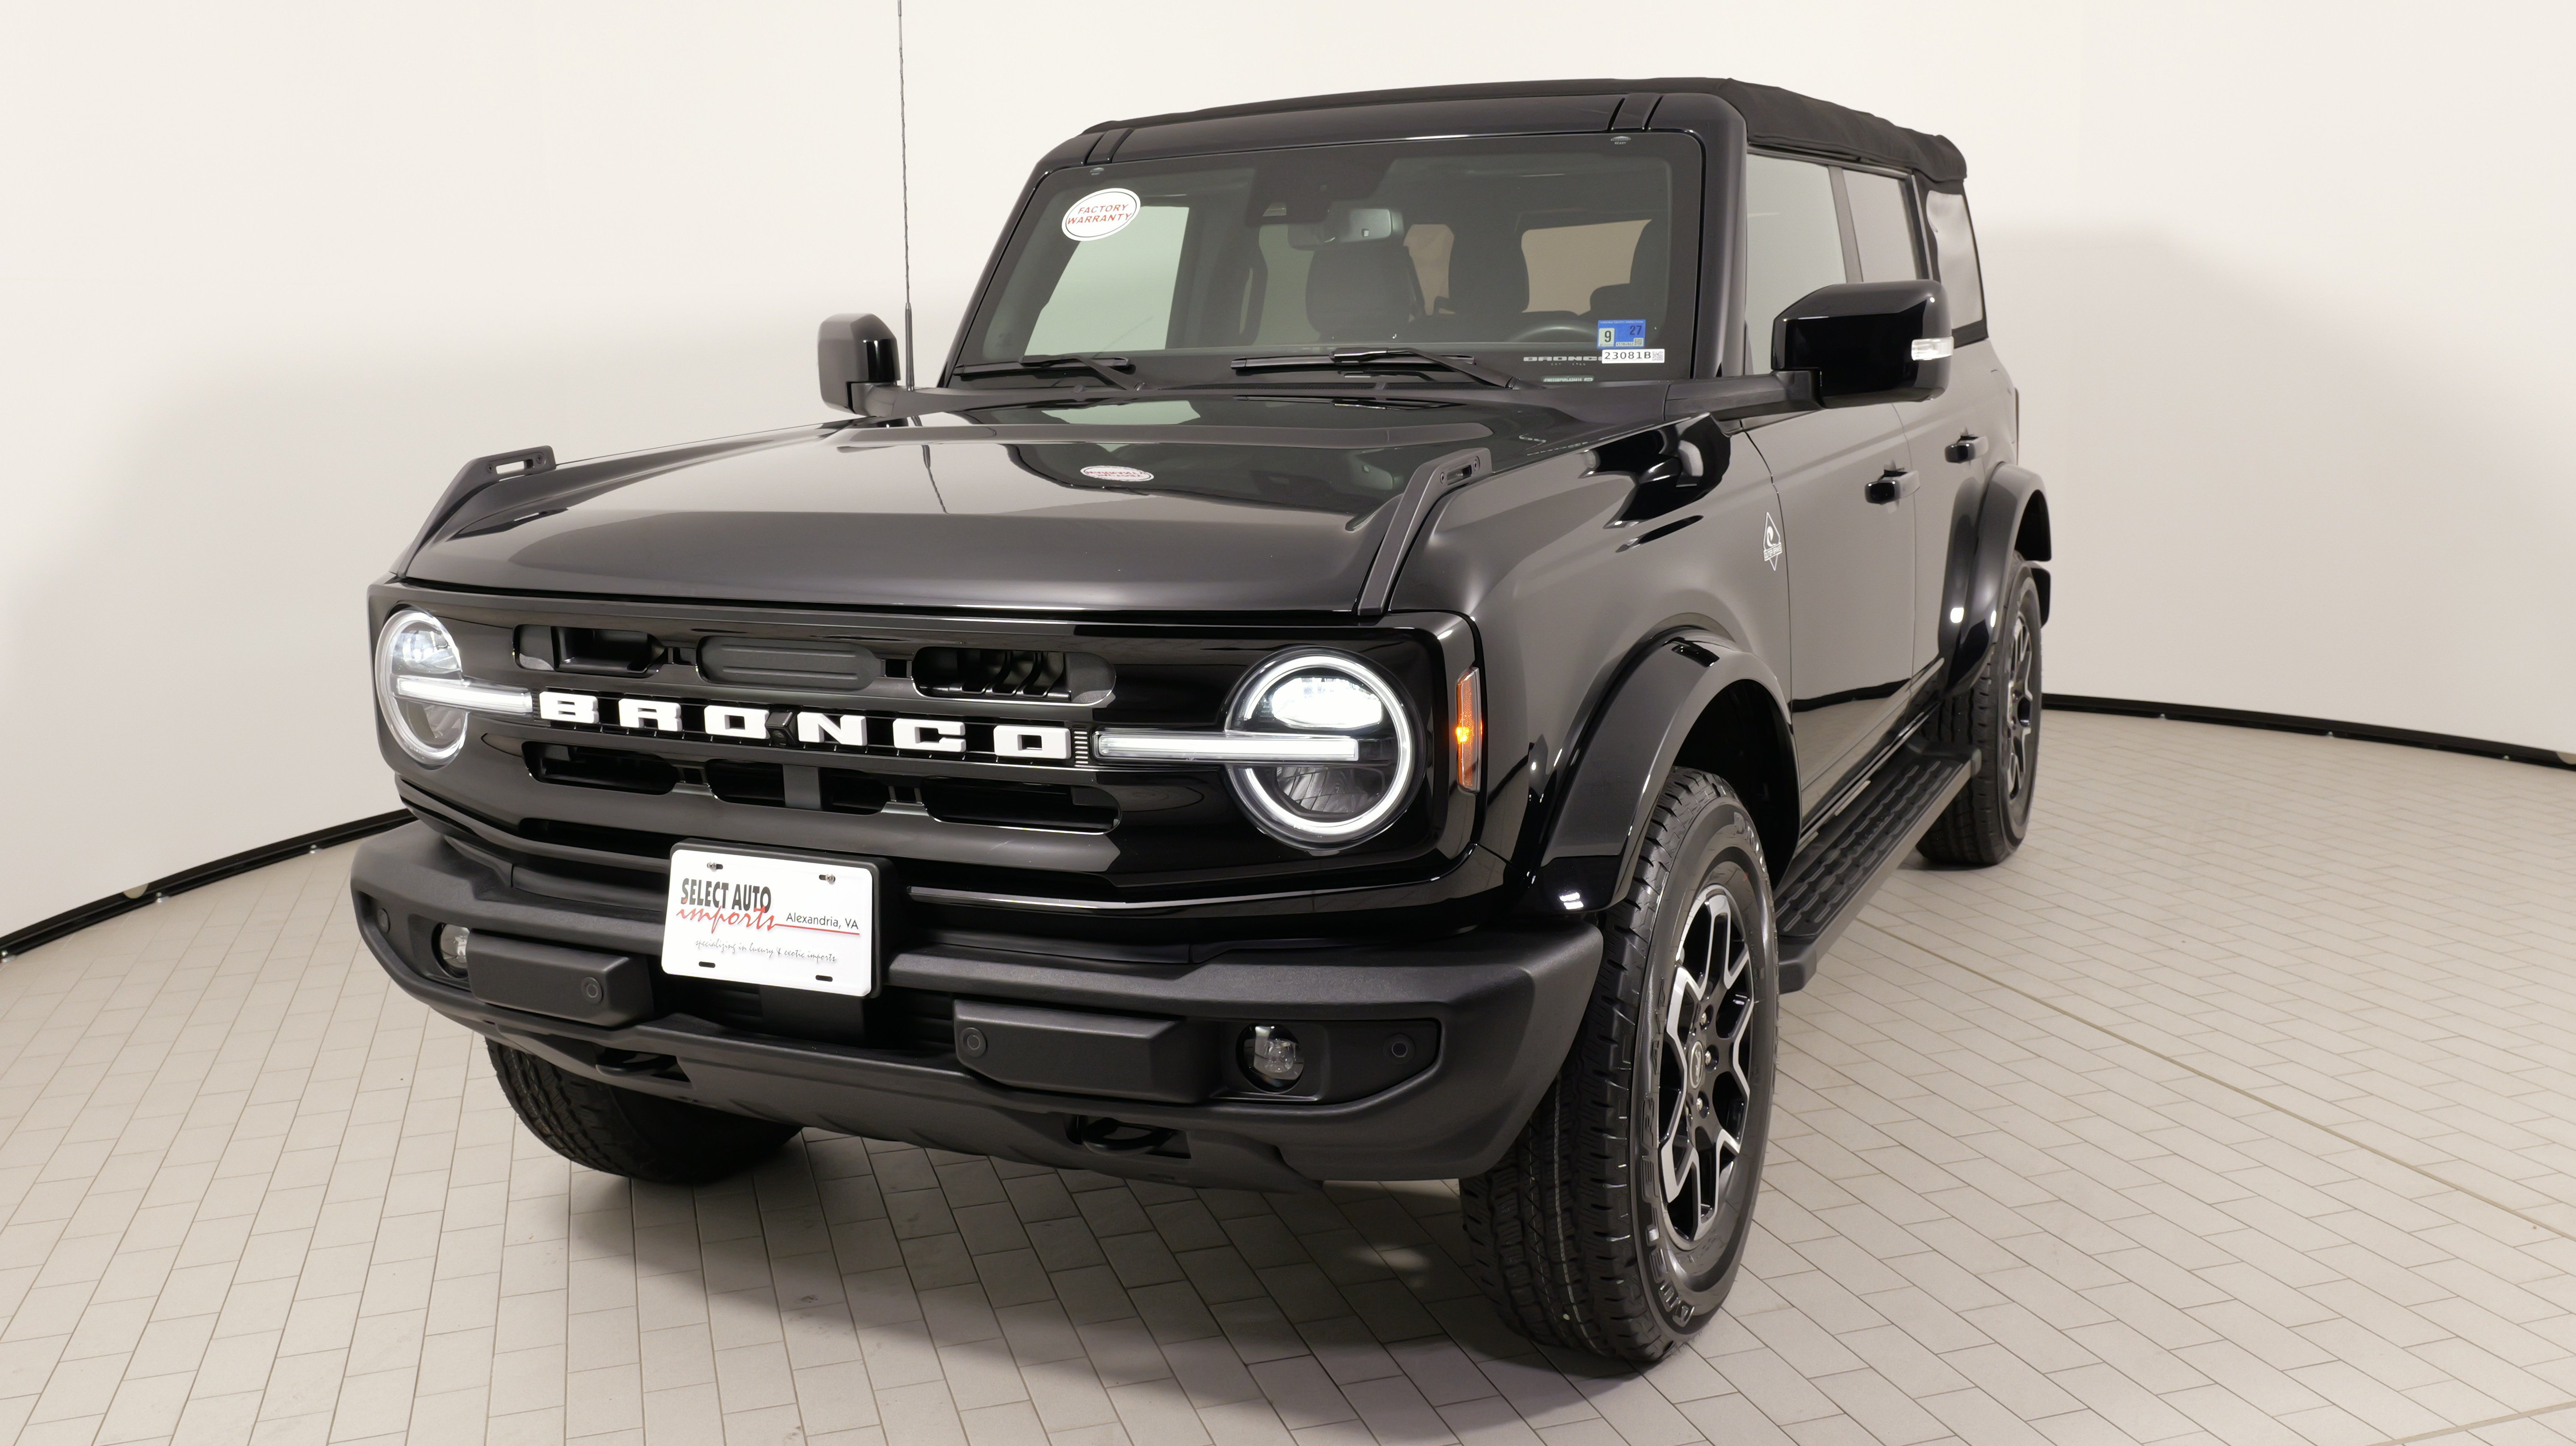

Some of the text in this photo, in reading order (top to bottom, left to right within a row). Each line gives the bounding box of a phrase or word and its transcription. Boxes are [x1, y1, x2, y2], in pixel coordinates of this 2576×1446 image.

[1078, 204, 1129, 214] FACTORY
[1068, 213, 1132, 225] WARRANTY
[1605, 330, 1611, 343] 9
[1629, 325, 1642, 335] 27
[1604, 351, 1651, 360] 23081B
[539, 691, 1072, 759] BRONCO
[680, 878, 771, 913] SELECT AUTO
[676, 905, 775, 934] imports
[786, 912, 859, 929] Alexandria, VA
[695, 938, 737, 954] specializing
[749, 942, 774, 958] luxury
[784, 949, 805, 958] exotic
[806, 950, 836, 964] imports
